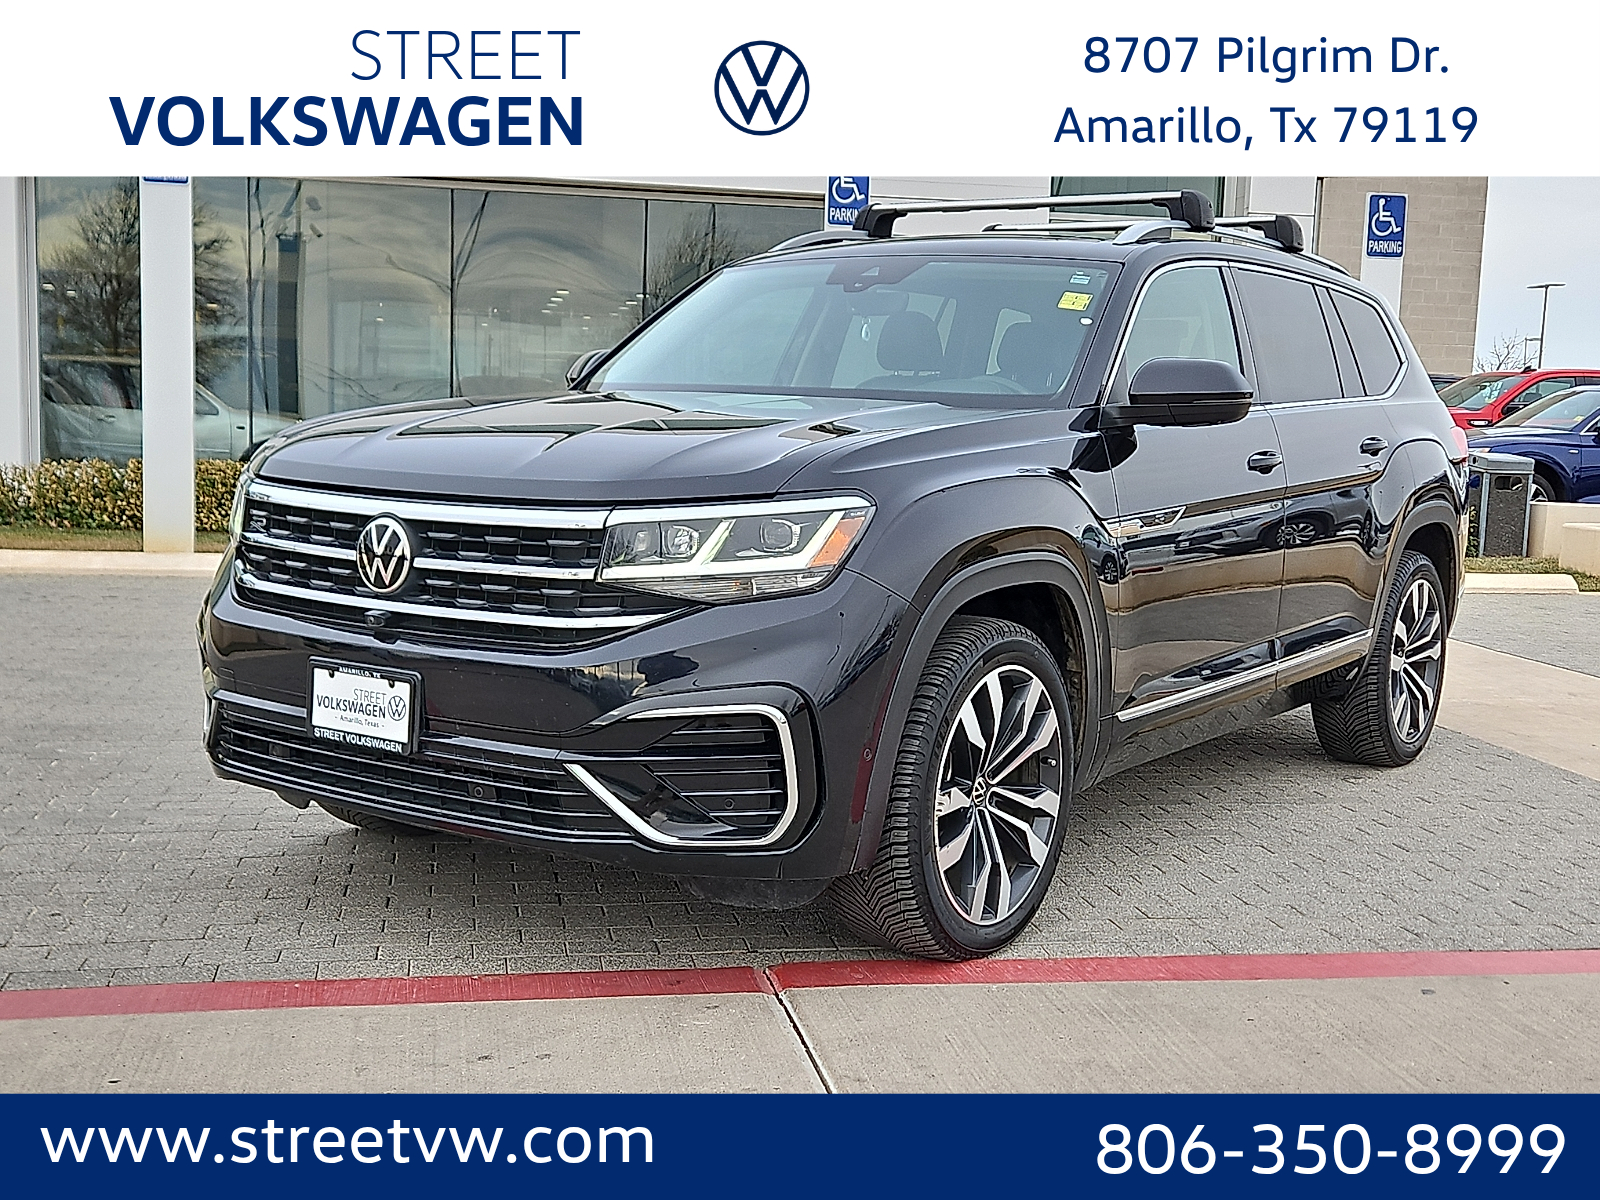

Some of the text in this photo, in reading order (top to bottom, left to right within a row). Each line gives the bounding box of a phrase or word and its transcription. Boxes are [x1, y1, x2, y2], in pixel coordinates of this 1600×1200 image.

[1368, 240, 1402, 254] PARKING
[357, 516, 411, 593] VW
[316, 694, 386, 719] VOLKSWAGEN
[353, 688, 387, 705] STREET
[364, 718, 380, 728] Texas
[313, 727, 403, 753] STREET VOLKSWAGEN
